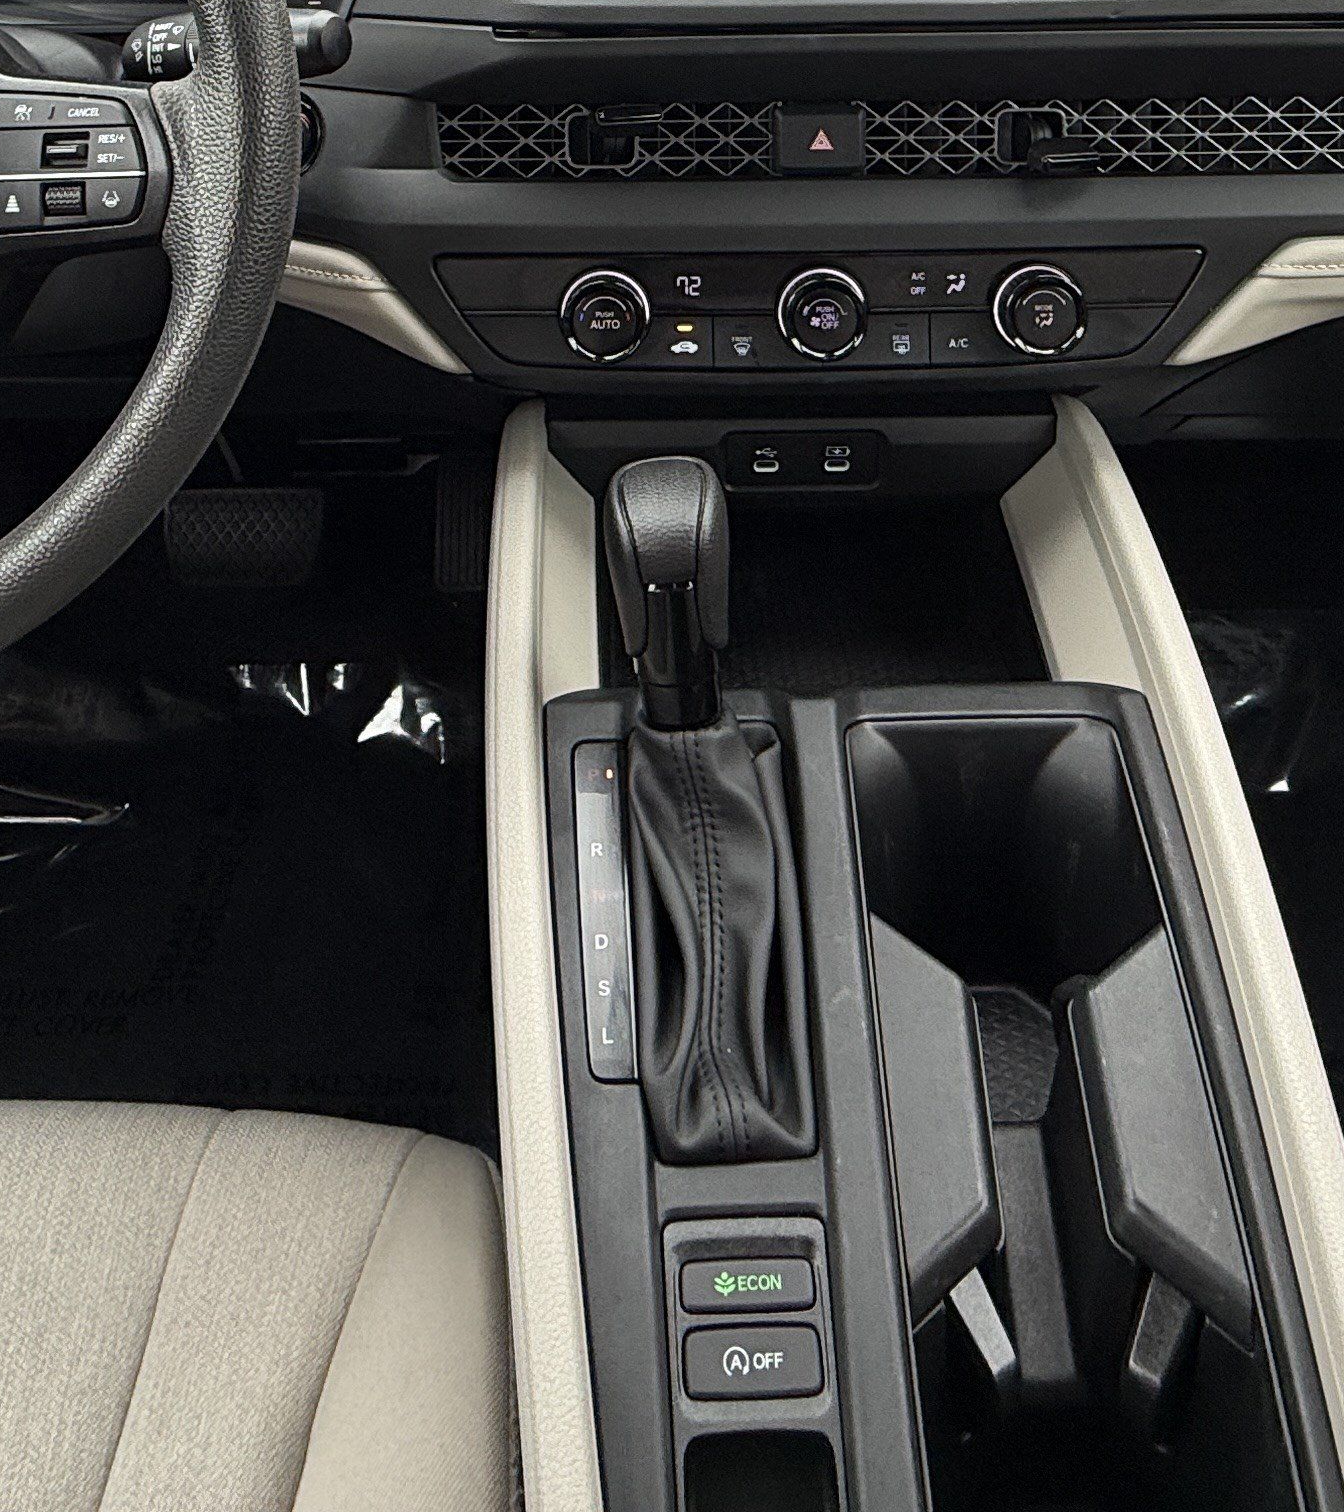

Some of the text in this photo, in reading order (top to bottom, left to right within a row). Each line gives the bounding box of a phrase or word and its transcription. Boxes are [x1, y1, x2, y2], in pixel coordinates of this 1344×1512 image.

[152, 32, 169, 42] OFF
[67, 107, 100, 118] CANCEL
[910, 272, 926, 281] A/C
[676, 275, 702, 297] 72
[910, 286, 927, 296] OFF
[594, 311, 615, 319] PUSH
[815, 306, 836, 314] PUSH
[589, 320, 621, 331] AUTO
[821, 321, 840, 330] OFF
[948, 339, 970, 349] A/C
[590, 842, 603, 858] R
[594, 934, 609, 950] D
[598, 979, 611, 997] S
[601, 1028, 614, 1044] L
[737, 1273, 783, 1292] ECON
[752, 1351, 784, 1370] OFF
